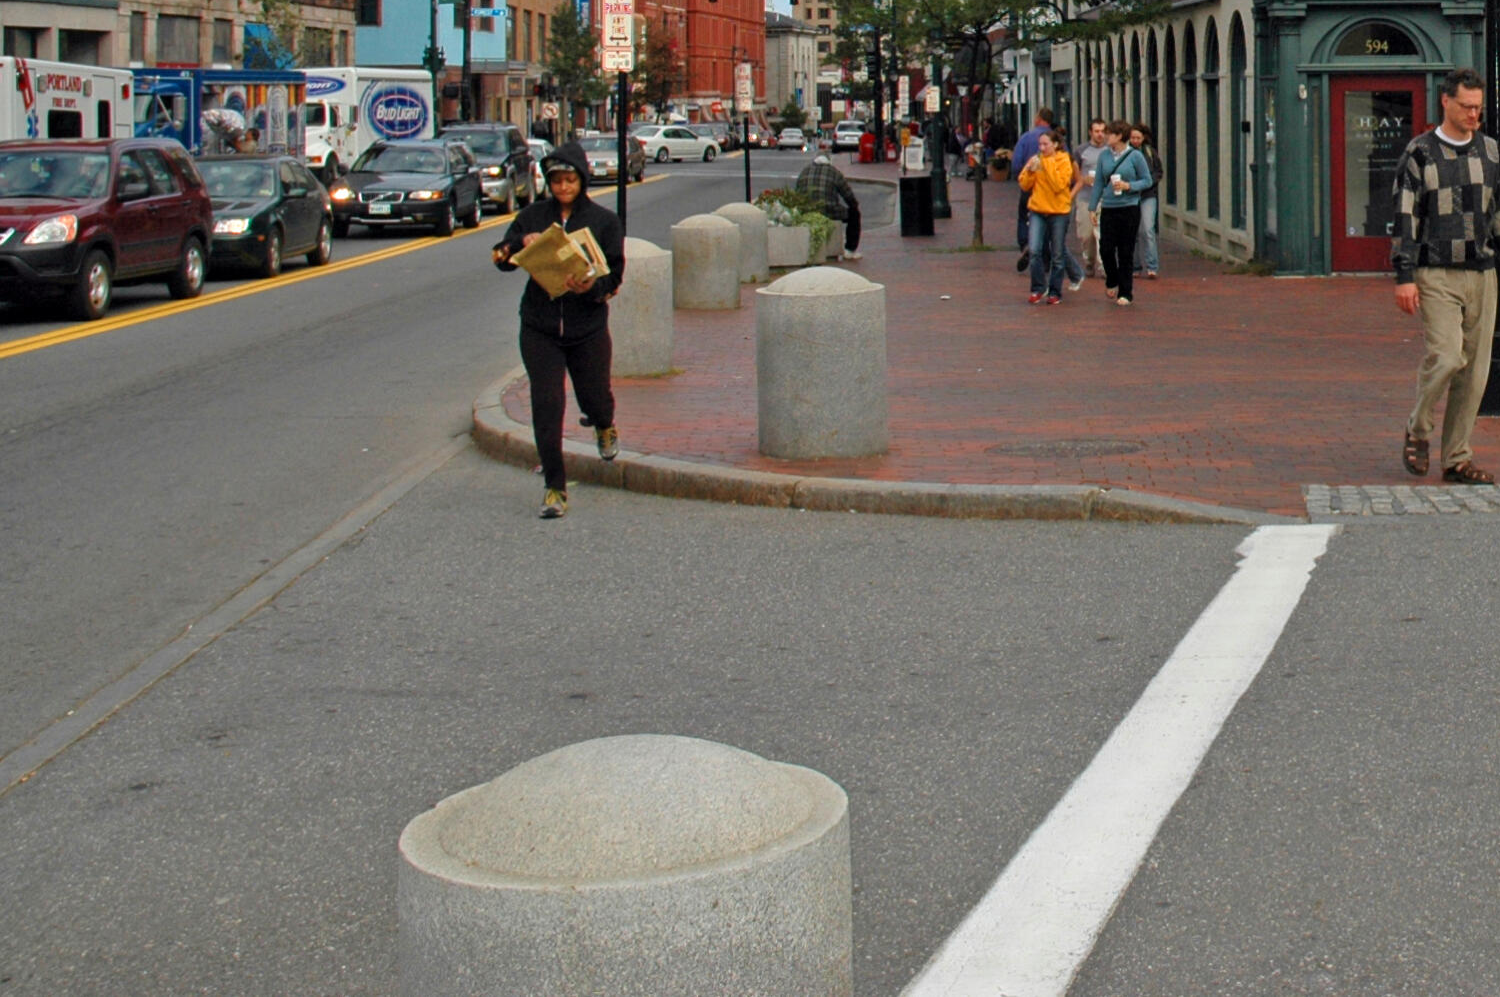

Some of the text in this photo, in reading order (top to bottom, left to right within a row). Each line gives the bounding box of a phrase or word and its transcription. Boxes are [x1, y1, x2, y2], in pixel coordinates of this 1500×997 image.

[1365, 39, 1389, 53] 594
[47, 73, 82, 92] PORTLAND
[396, 106, 421, 121] LIGHT
[1360, 117, 1403, 128] HAY
